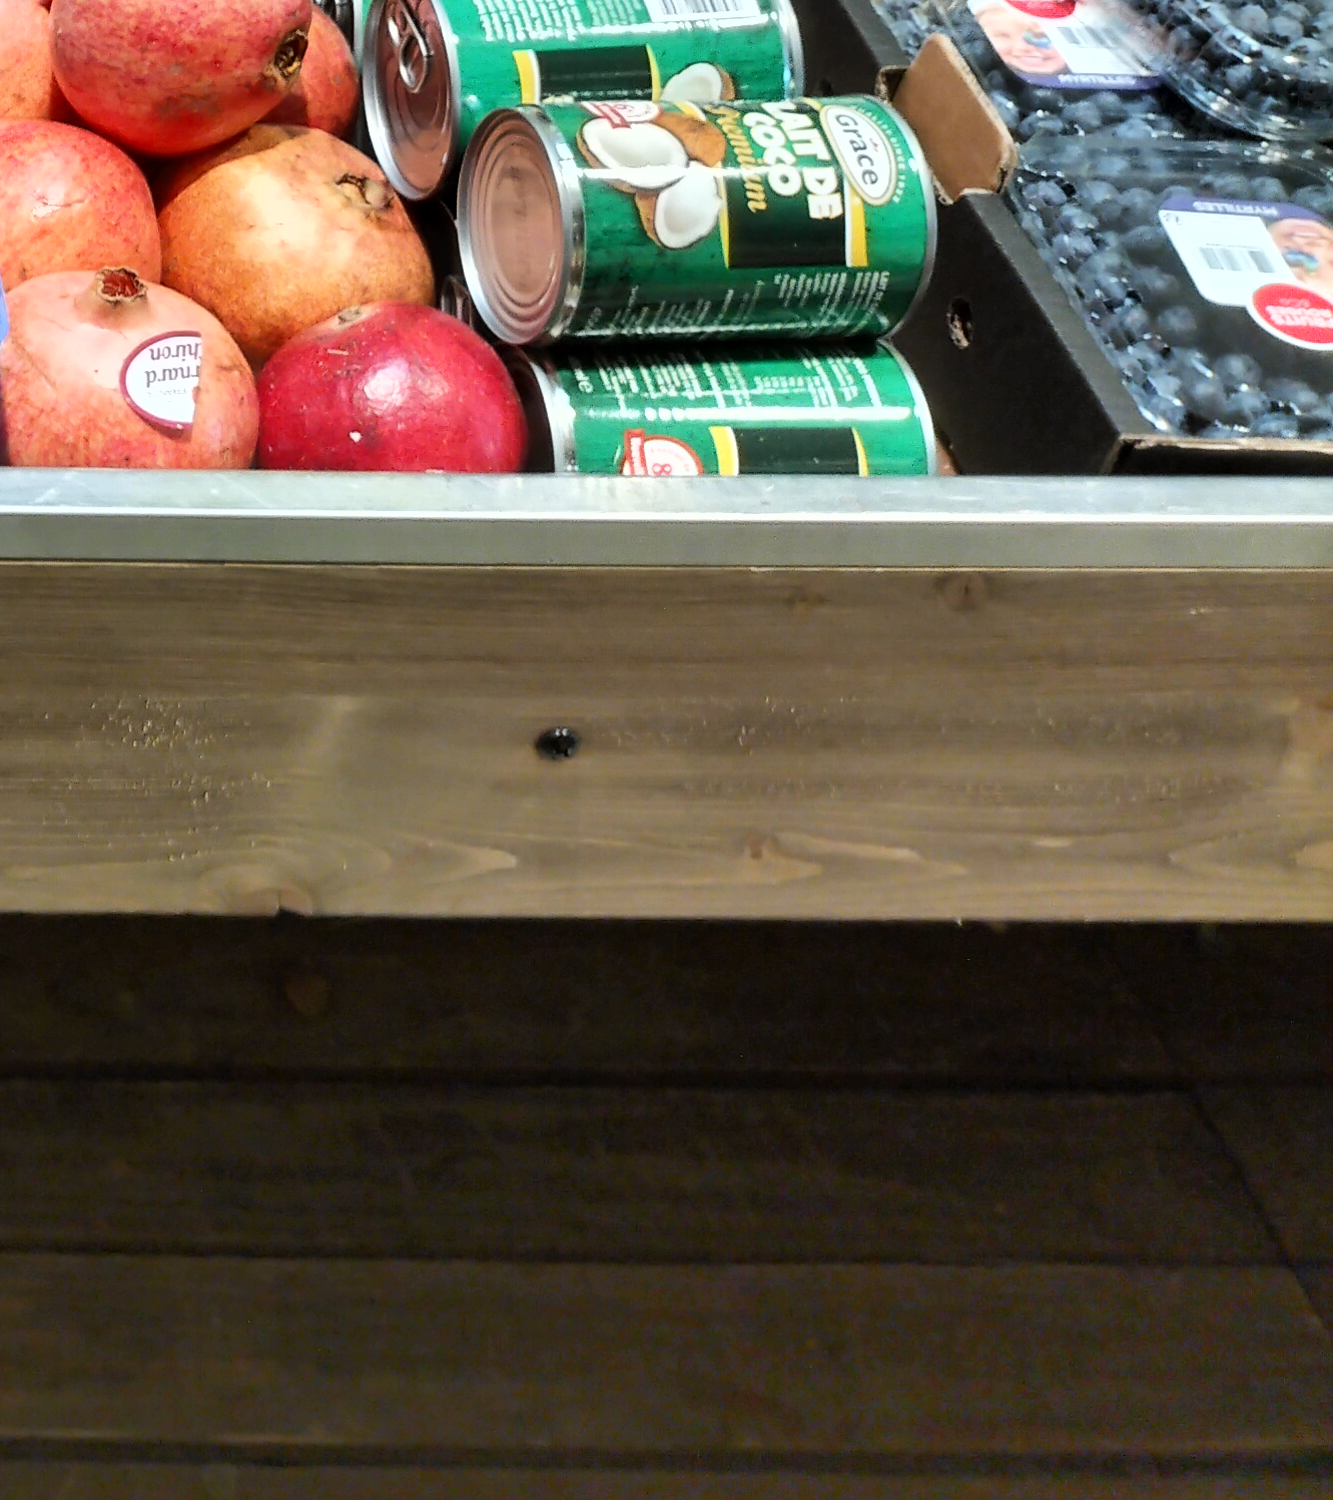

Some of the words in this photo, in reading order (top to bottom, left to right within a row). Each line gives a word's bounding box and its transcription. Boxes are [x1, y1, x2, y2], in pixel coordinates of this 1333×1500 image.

[704, 105, 769, 214] Premium
[742, 111, 803, 197] COCO
[761, 101, 832, 169] LAIT
[800, 166, 845, 220] DE
[834, 112, 880, 188] Grace
[144, 364, 201, 389] rnard
[149, 342, 201, 362] hiron
